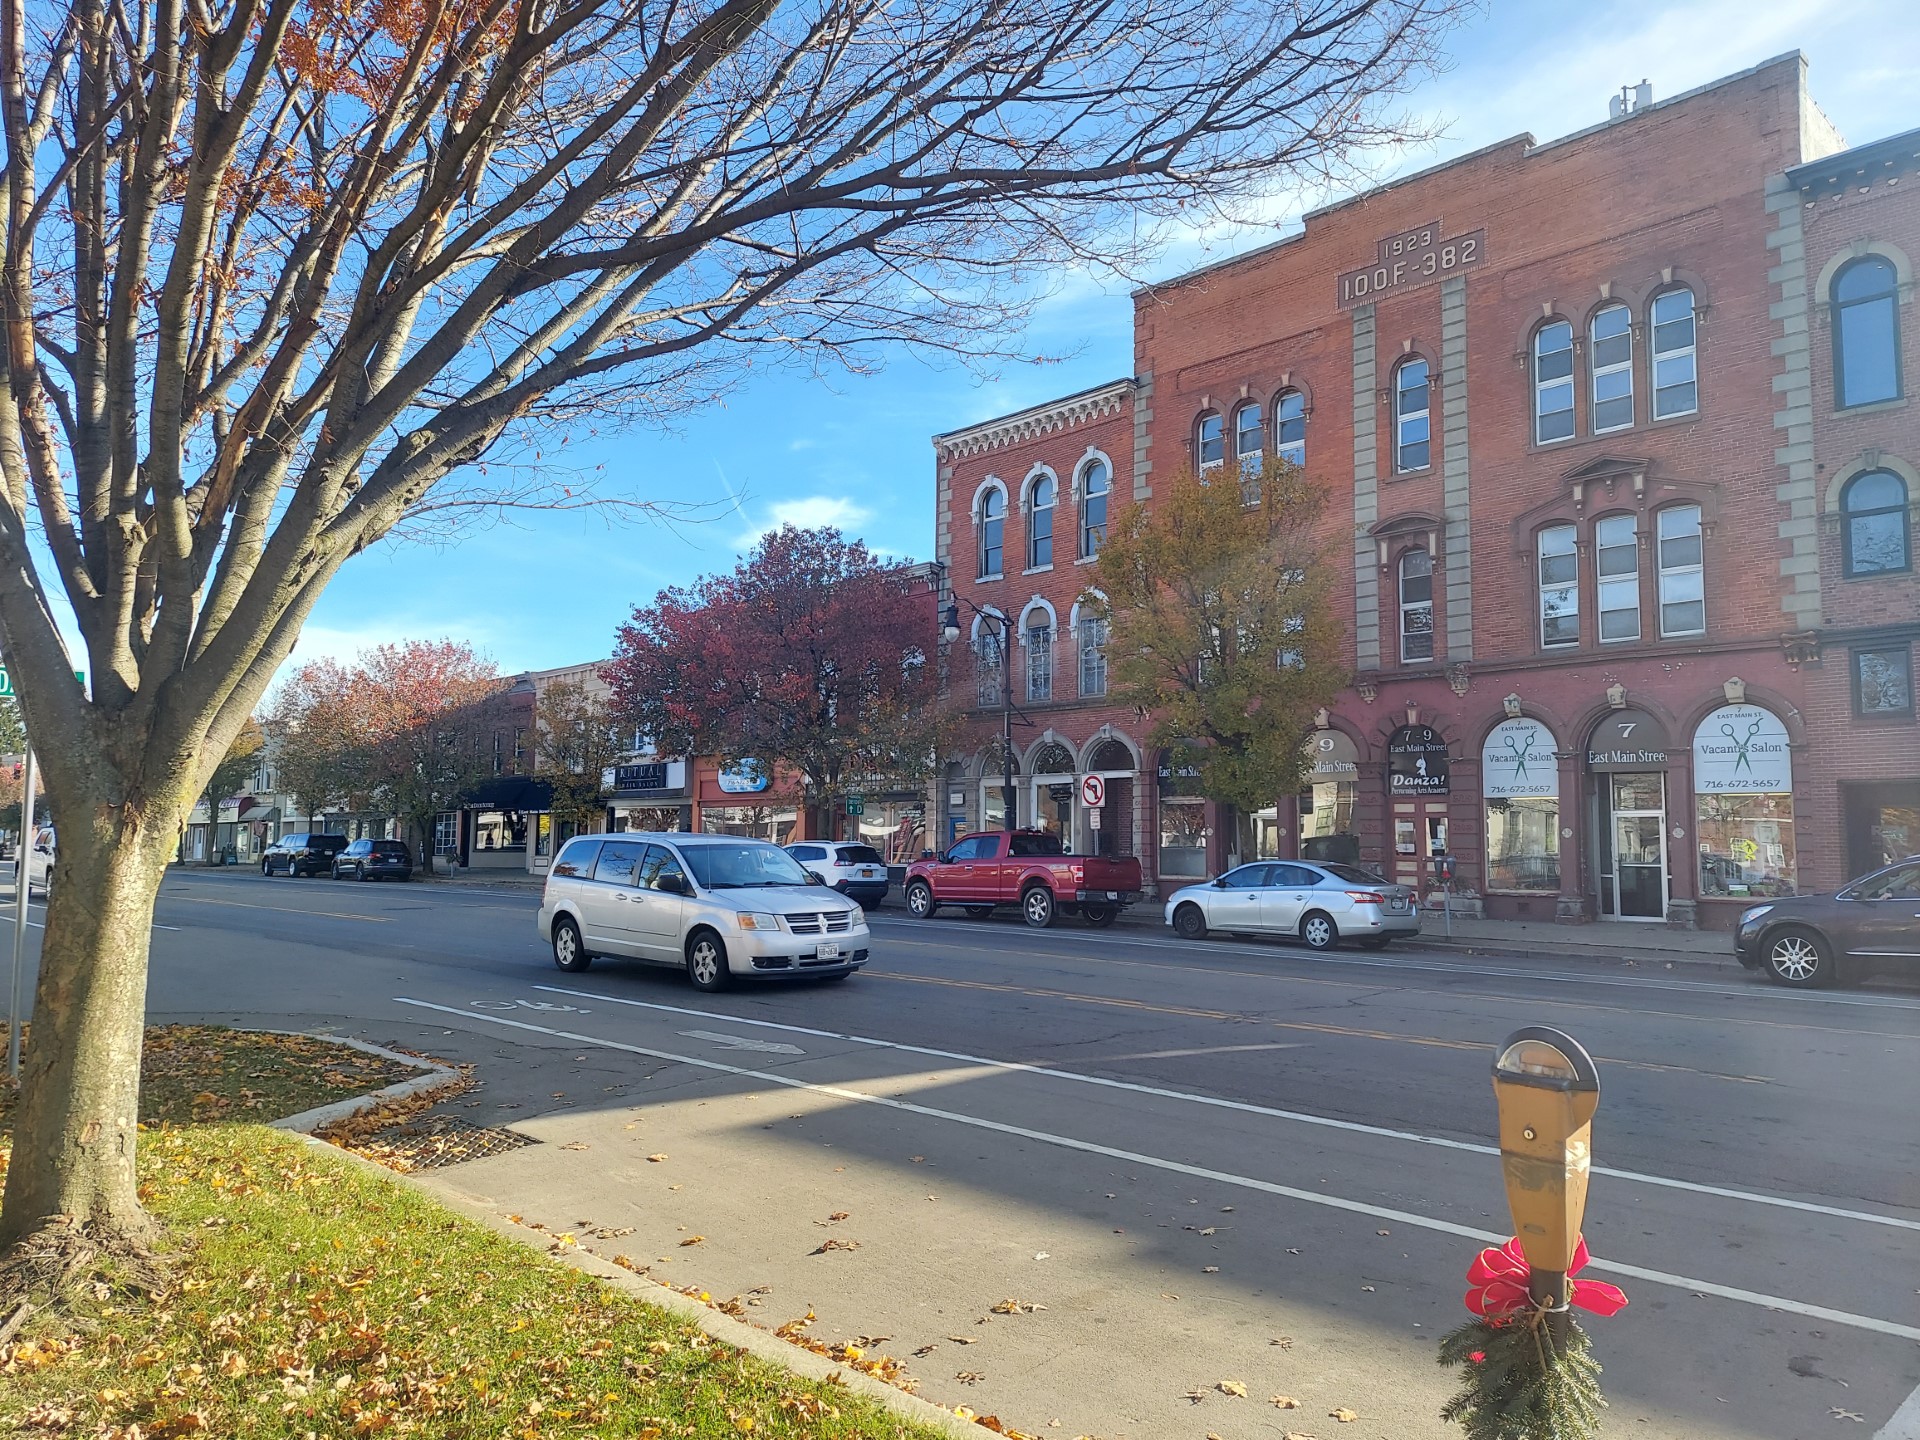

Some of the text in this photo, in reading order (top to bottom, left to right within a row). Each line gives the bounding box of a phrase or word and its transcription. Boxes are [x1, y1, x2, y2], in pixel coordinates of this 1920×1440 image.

[1385, 230, 1431, 258] 1923
[1617, 723, 1637, 738] 7
[1319, 738, 1334, 751] 9
[1390, 743, 1447, 753] East Main Street
[1751, 742, 1782, 753] Salon
[1527, 752, 1552, 762] Salon
[1588, 750, 1609, 764] East
[1611, 750, 1637, 763] Main
[620, 765, 661, 778] RITUAL
[1314, 760, 1334, 773] Main
[1393, 774, 1445, 786] Danza!
[1704, 779, 1781, 789] 716-672-5657
[1490, 785, 1551, 793] 716-672-5657
